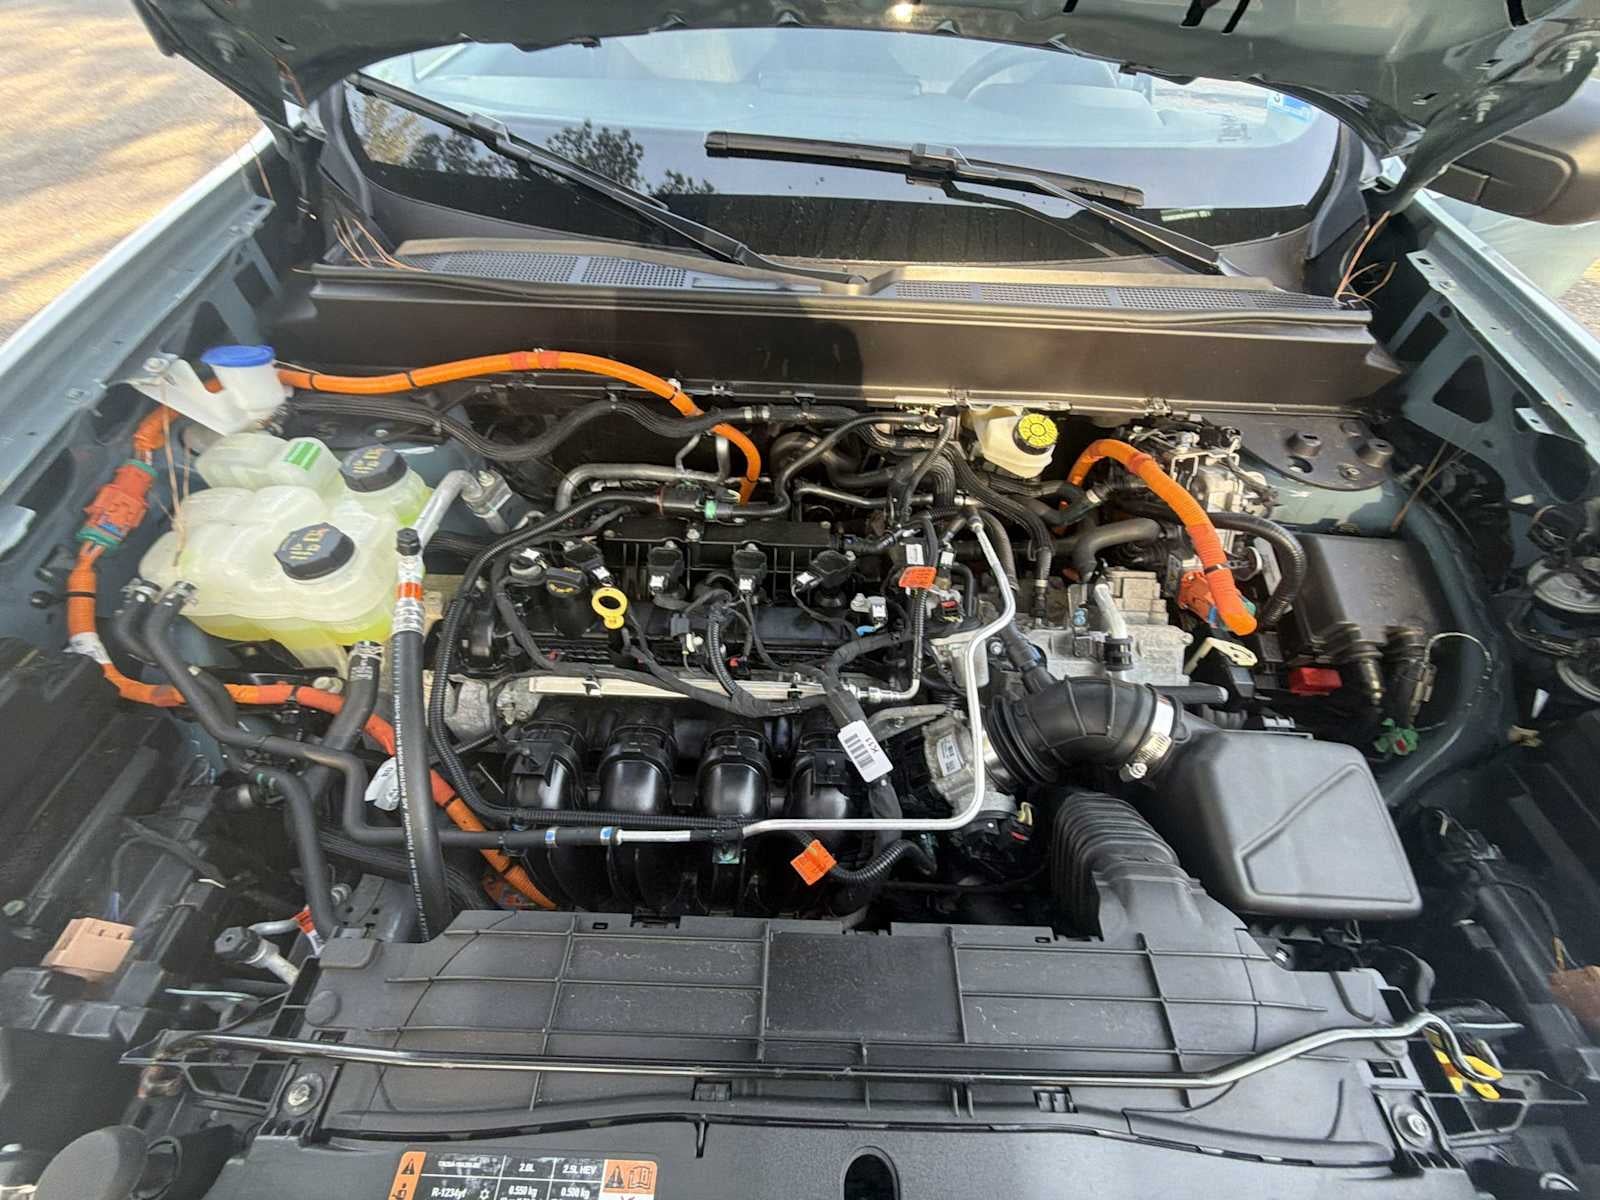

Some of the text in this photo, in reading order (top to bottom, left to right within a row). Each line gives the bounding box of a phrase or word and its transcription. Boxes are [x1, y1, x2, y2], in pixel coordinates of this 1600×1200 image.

[580, 1165, 598, 1175] HEV
[431, 1187, 467, 1199] R-1234yf
[528, 1186, 539, 1198] kg
[580, 1187, 590, 1199] kg
